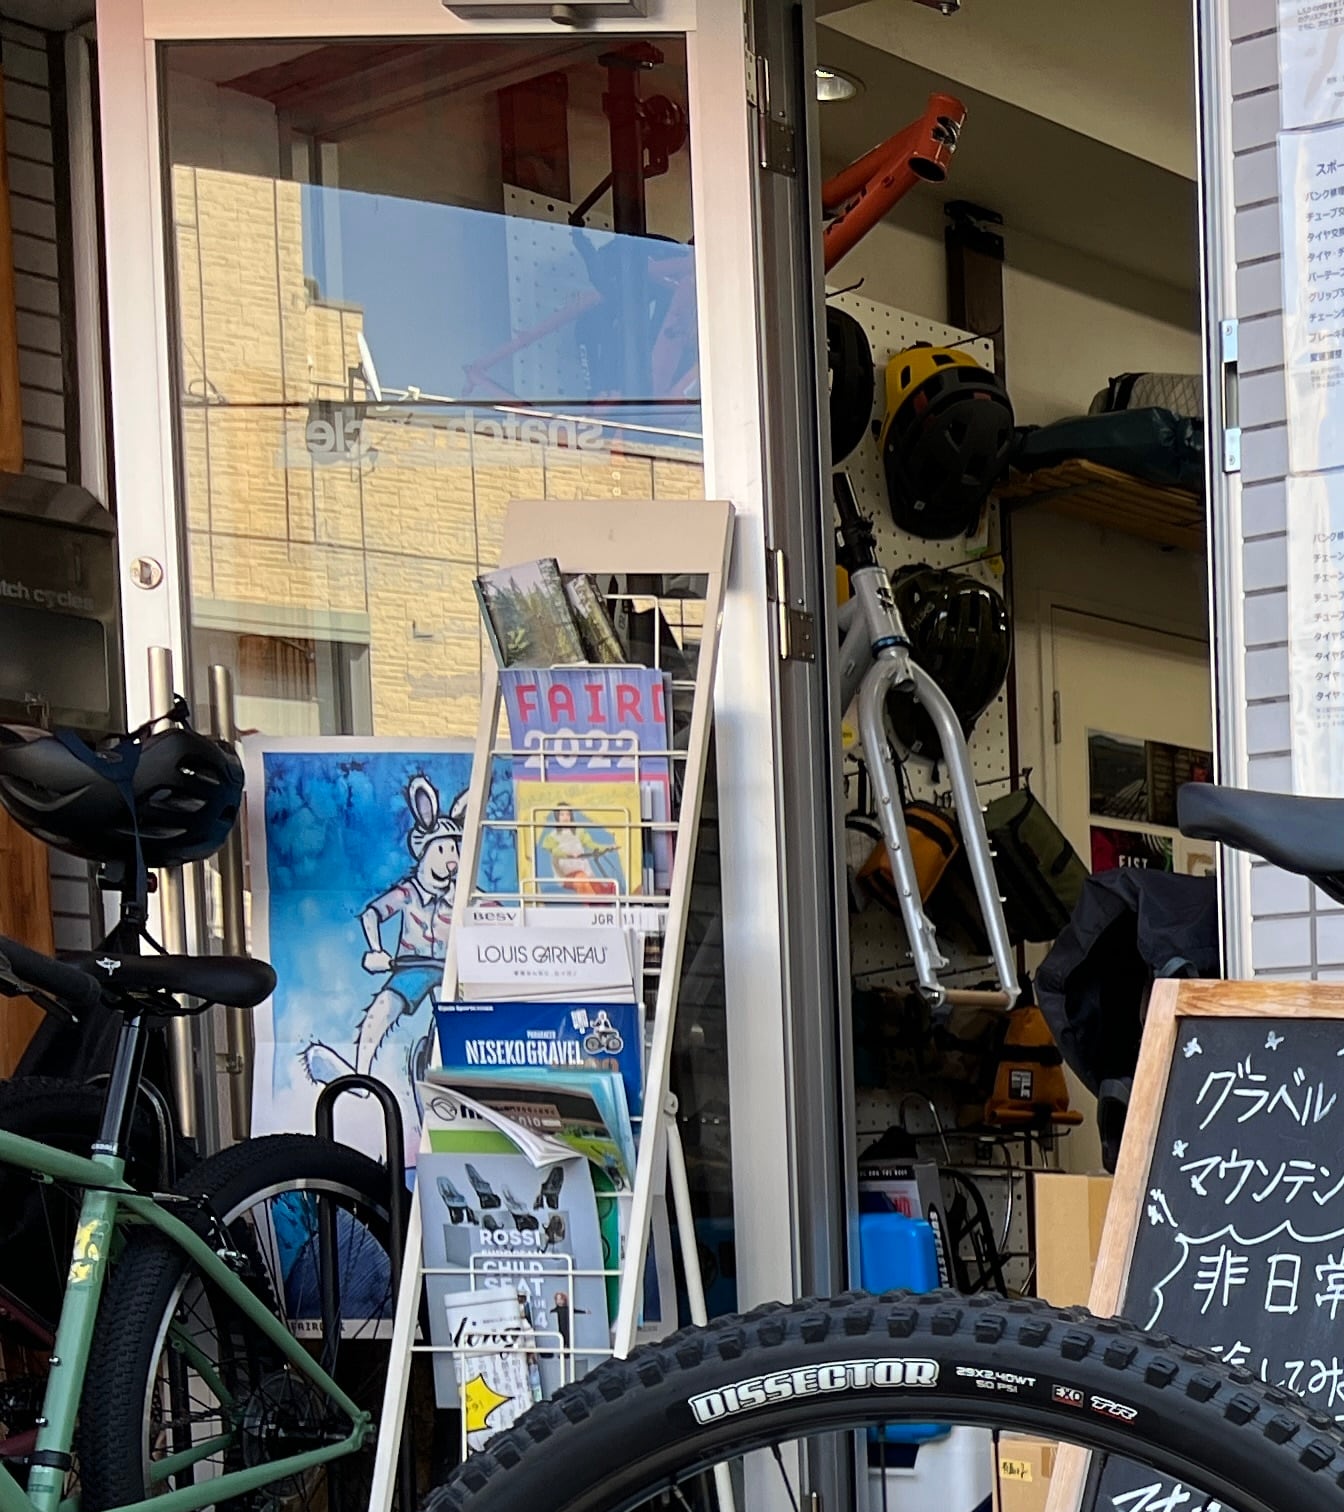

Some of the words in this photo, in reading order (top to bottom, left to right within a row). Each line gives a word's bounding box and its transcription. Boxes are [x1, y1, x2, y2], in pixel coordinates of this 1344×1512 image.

[524, 728, 638, 769] 2022
[477, 945, 528, 964] LOUIS
[532, 945, 606, 965] GARNEAU
[465, 1040, 525, 1065] NISEKO
[526, 1040, 584, 1066] GRAVEL
[479, 1229, 541, 1246] ROSSI
[688, 1357, 940, 1425] DISSECTOR
